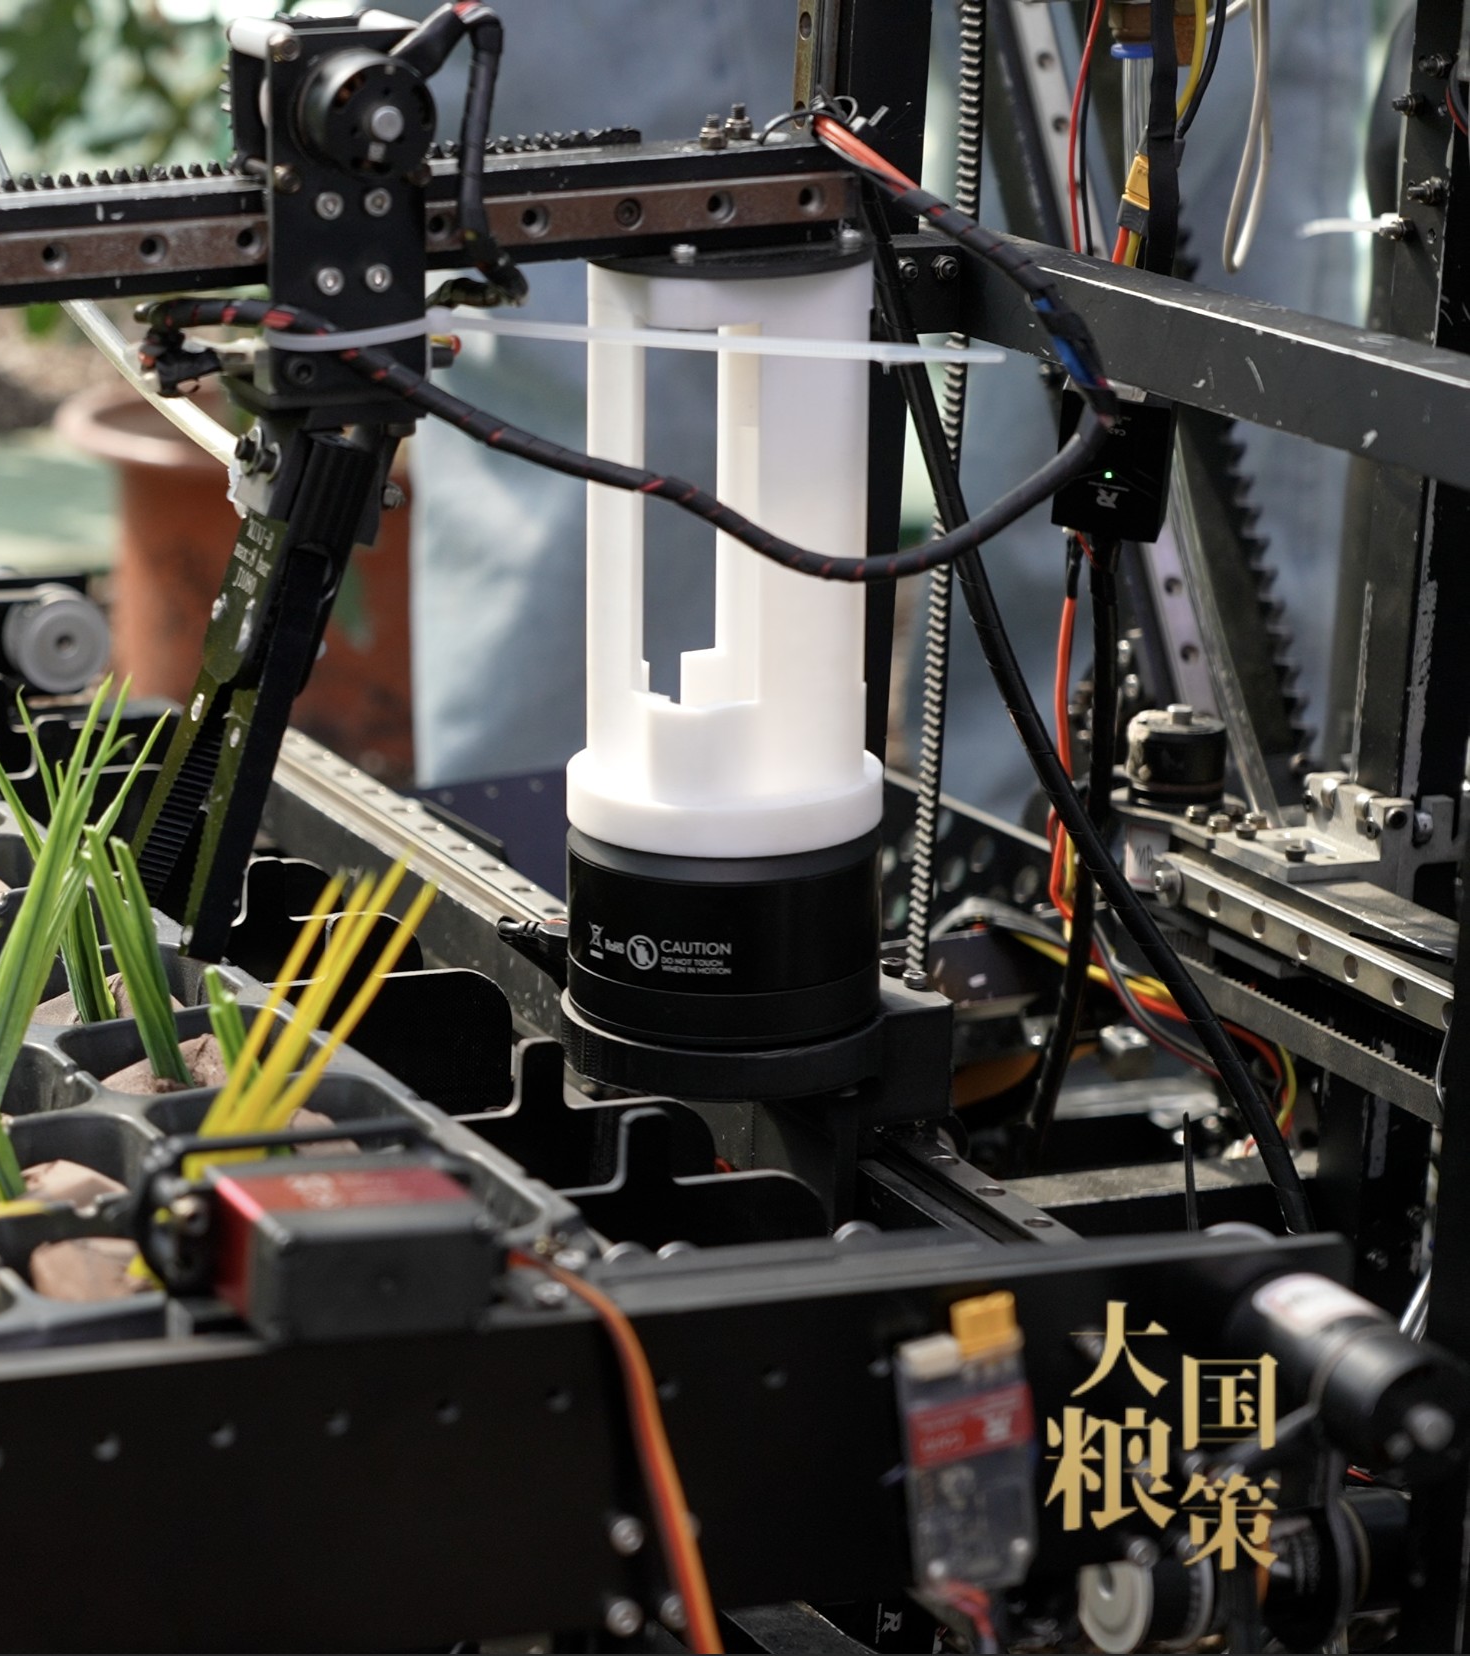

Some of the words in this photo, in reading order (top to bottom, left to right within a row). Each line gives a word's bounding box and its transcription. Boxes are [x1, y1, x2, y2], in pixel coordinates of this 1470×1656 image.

[604, 938, 625, 954] RoHS
[660, 940, 732, 955] CAUTION
[661, 956, 674, 965] DO
[674, 958, 692, 966] NOT
[693, 959, 724, 967] TOUCH
[661, 965, 687, 974] WHEN
[697, 967, 732, 975] MOTION
